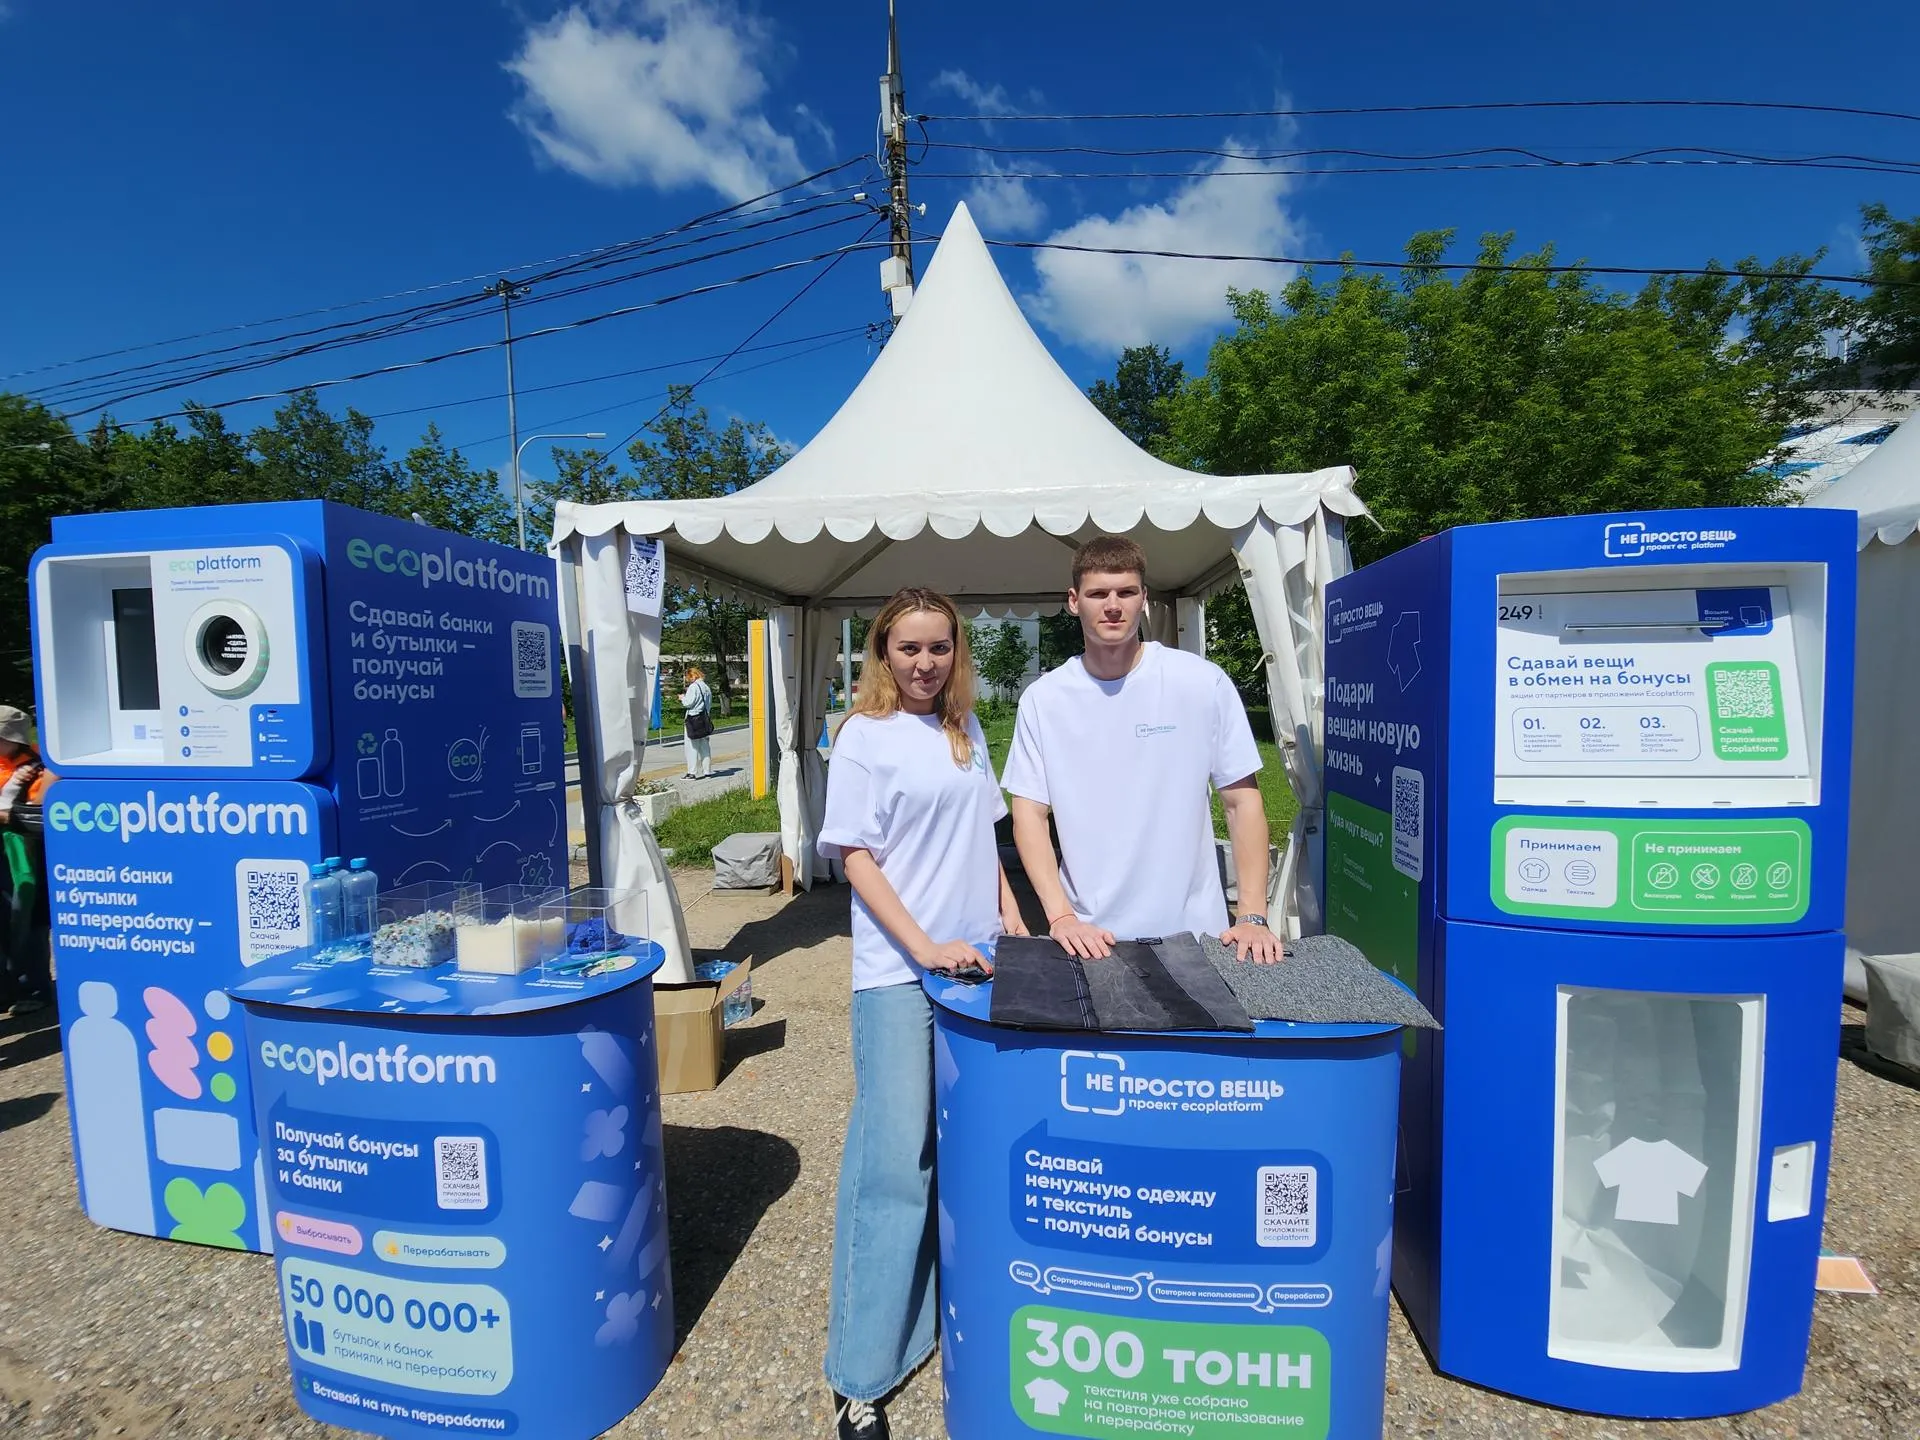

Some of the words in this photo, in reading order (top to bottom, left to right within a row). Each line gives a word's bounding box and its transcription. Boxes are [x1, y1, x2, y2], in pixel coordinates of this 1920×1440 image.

[1620, 534, 1638, 545] НЕ
[1641, 531, 1697, 543] ПРОСТО
[1700, 530, 1737, 541] ВЕЩЬ
[1646, 543, 1675, 551] проект
[169, 555, 261, 574] ecoplatform
[346, 538, 550, 600] ecoplatform
[349, 600, 434, 629] Сдавай
[439, 612, 493, 635] банки
[1341, 606, 1363, 625] ПРОСТО
[1365, 601, 1383, 618] ВЕЩЬ
[351, 632, 365, 649] и
[371, 628, 458, 655] бутылки
[352, 656, 444, 680] получай
[1508, 655, 1577, 673] Сдавай
[1584, 656, 1635, 671] вещи
[353, 679, 435, 704] бонусы
[1509, 676, 1518, 686] в
[1524, 672, 1583, 686] обмен
[1590, 674, 1612, 685] на
[1617, 671, 1691, 688] бонусы
[1328, 677, 1374, 711] Подари
[1545, 692, 1588, 700] партнеров
[1646, 690, 1695, 698] Ecoplatform
[1523, 718, 1545, 730] 01.
[1579, 717, 1606, 730] 02.
[1639, 716, 1666, 729] 03.
[1719, 726, 1753, 734] Скачай
[1328, 717, 1366, 742] вещам
[1369, 724, 1421, 754] новую
[451, 754, 478, 768] eco
[1721, 745, 1778, 754] Ecoplatform
[1327, 748, 1364, 776] жизнь
[49, 790, 308, 844] ecoplatform
[1330, 809, 1344, 829] Куда
[1360, 831, 1384, 849] вещи?
[1520, 839, 1601, 852] Принимаем
[1645, 842, 1665, 854] Не
[1668, 844, 1742, 857] принимаем
[54, 864, 116, 884] Сдавай
[120, 865, 173, 885] банки
[56, 889, 66, 903] и
[69, 887, 137, 908] бутылки
[57, 911, 77, 926] на
[81, 912, 194, 935] переработку
[59, 933, 127, 953] получай
[130, 934, 195, 956] бонусы
[250, 931, 280, 940] Скачай
[261, 1040, 496, 1086] ecoplatform
[1086, 1073, 1114, 1093] НЕ
[1119, 1076, 1215, 1099] ПРОСТО
[1220, 1080, 1284, 1102] ВЕЩЬ
[1128, 1099, 1178, 1112] проект
[1181, 1099, 1263, 1115] ecoplatform
[275, 1121, 345, 1150] Получай
[348, 1133, 419, 1160] бонусы
[277, 1147, 295, 1164] за
[298, 1148, 368, 1176] бутылки
[1025, 1149, 1103, 1175] Сдавай
[279, 1169, 289, 1183] и
[293, 1169, 343, 1194] банки
[443, 1182, 480, 1190] СКАЧИВАЙ
[1025, 1173, 1132, 1200] ненужную
[1136, 1185, 1217, 1209] одежду
[1025, 1194, 1038, 1208] и
[1042, 1194, 1133, 1220] текстиль
[1044, 1216, 1130, 1242] получай
[1134, 1224, 1213, 1249] бонусы
[1264, 1217, 1309, 1226] СКАЧАЙТЕ
[296, 1225, 352, 1245] Выбрасывать
[403, 1244, 490, 1258] Перерабатывать
[1016, 1269, 1033, 1278] Бокс
[1050, 1274, 1111, 1289] Сортировочный
[1112, 1284, 1135, 1293] центр
[290, 1274, 324, 1309] 50
[333, 1284, 395, 1324] 000
[404, 1299, 501, 1334] 000+
[1155, 1288, 1197, 1297] Повторное
[1198, 1291, 1256, 1299] использование
[1274, 1292, 1325, 1300] Переработка
[332, 1328, 381, 1350] бутылок
[384, 1342, 392, 1352] и
[394, 1340, 433, 1360] банок
[1025, 1317, 1145, 1379] 300
[1162, 1348, 1312, 1389] тонн
[334, 1345, 384, 1367] приняли
[387, 1356, 402, 1370] на
[405, 1361, 498, 1382] переработку
[313, 1381, 360, 1407] Вставай
[363, 1397, 378, 1411] на
[381, 1402, 409, 1420] путь
[411, 1408, 505, 1430] переработки
[1084, 1384, 1148, 1402] текстиля
[1151, 1392, 1179, 1407] уже
[1183, 1393, 1249, 1409] собрано
[1084, 1399, 1103, 1410] на
[1106, 1401, 1186, 1421] повторное
[1190, 1409, 1305, 1426] использование
[1084, 1413, 1093, 1423] и
[1096, 1413, 1195, 1437] переработку
